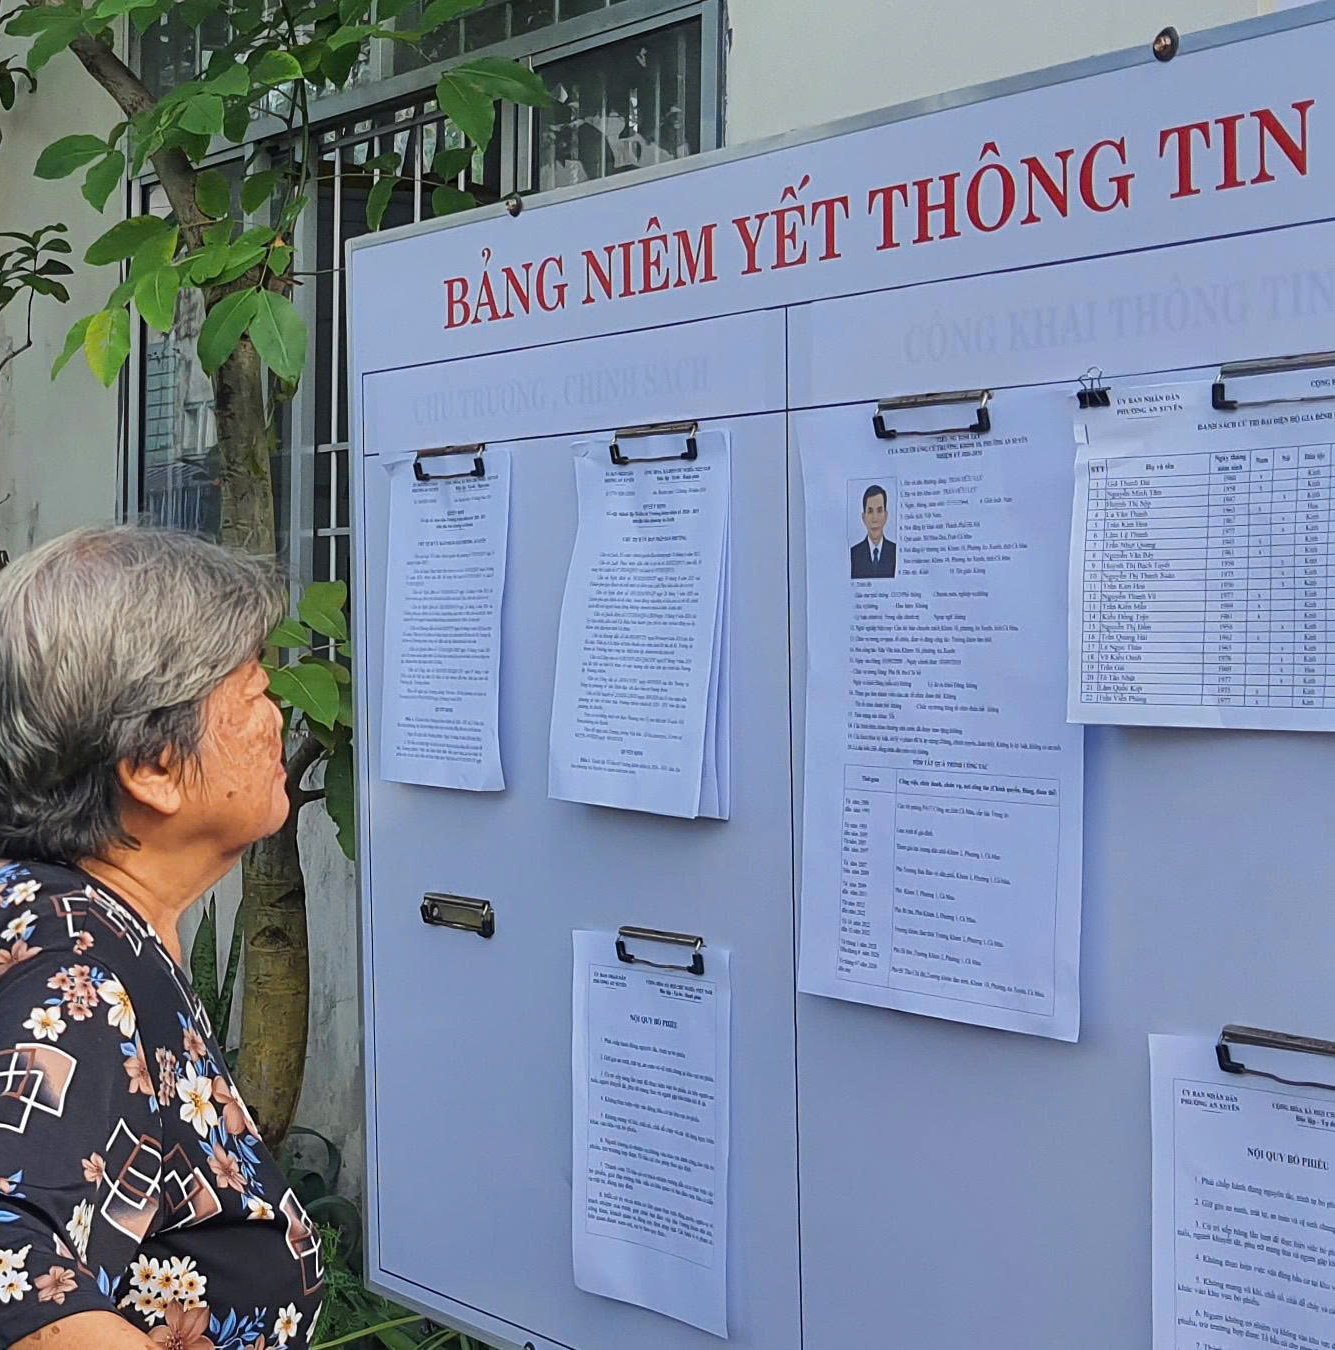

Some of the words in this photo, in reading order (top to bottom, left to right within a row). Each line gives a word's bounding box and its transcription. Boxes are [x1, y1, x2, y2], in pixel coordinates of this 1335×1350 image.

[444, 247, 568, 329] BẢNG
[582, 216, 717, 304] NIÊM
[732, 174, 849, 275] YẾT
[869, 141, 1136, 250] THÔNG
[1159, 99, 1315, 195] TIN
[905, 309, 996, 363] CÔNG
[1009, 299, 1097, 352] KHAI
[1106, 272, 1250, 341] THÔNG
[1262, 266, 1335, 321] TIN
[1192, 1089, 1204, 1098] BAN
[1207, 1091, 1224, 1100] NHÂN
[1225, 1093, 1238, 1102] DÂN
[1209, 1101, 1218, 1109] AN
[1219, 1100, 1240, 1112] XUYÊN
[1247, 1147, 1264, 1160] NỘI
[1266, 1150, 1285, 1163] QUY
[1288, 1153, 1300, 1165] BỎ
[1302, 1157, 1330, 1171] PHIẾU
